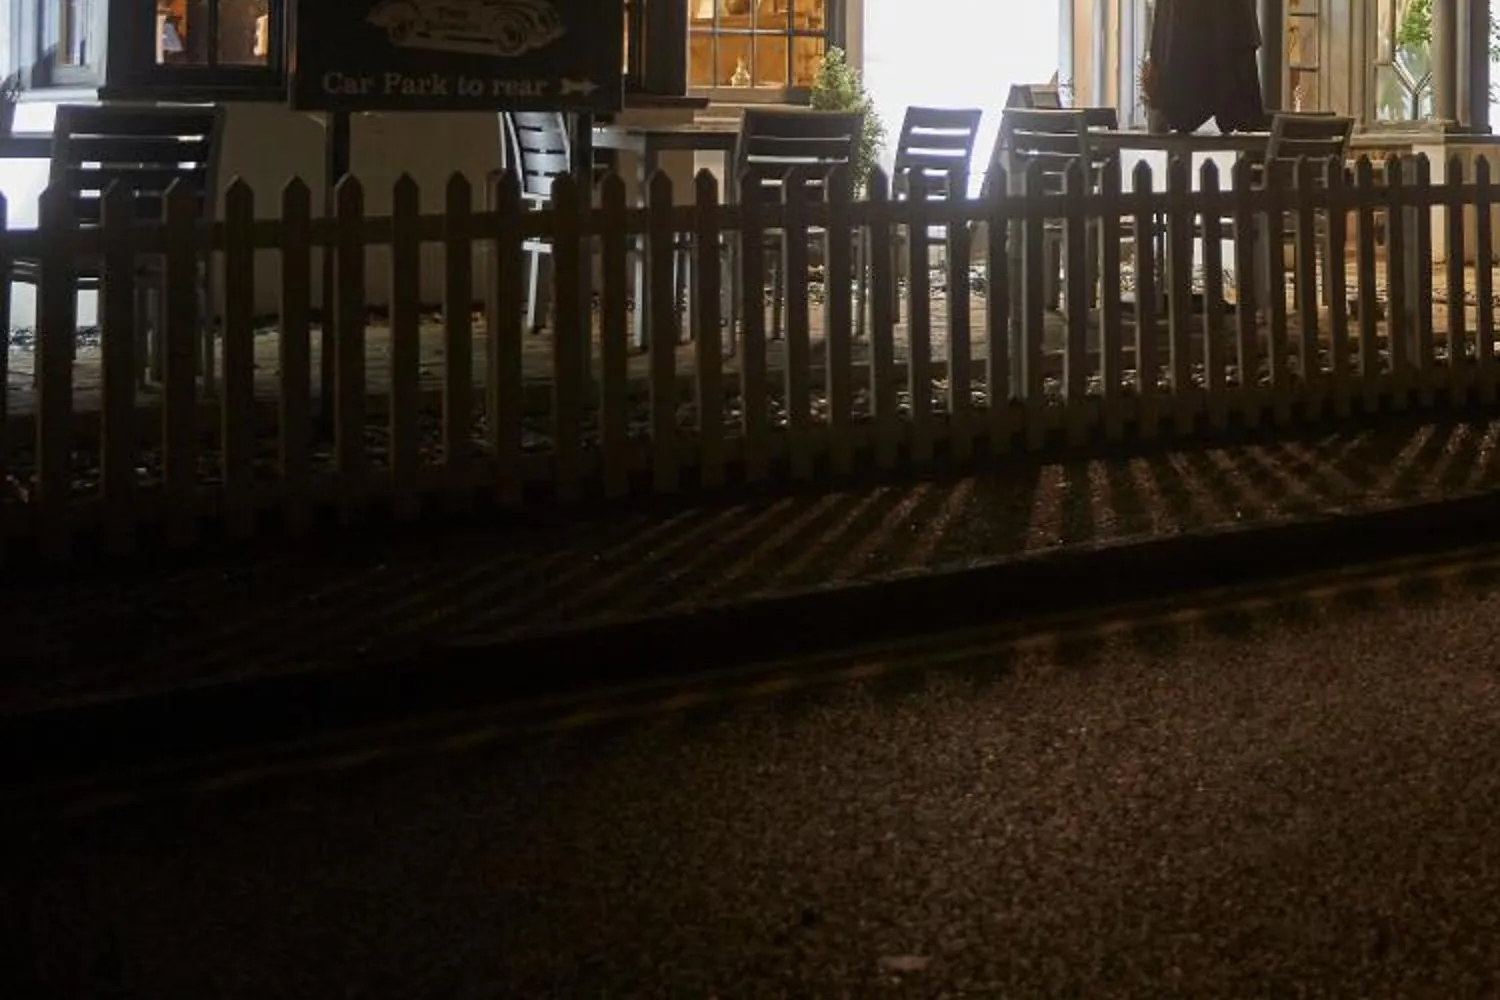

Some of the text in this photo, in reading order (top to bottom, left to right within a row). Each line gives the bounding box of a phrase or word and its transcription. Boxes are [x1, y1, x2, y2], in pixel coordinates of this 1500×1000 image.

[322, 71, 549, 98] Car Park to rear
